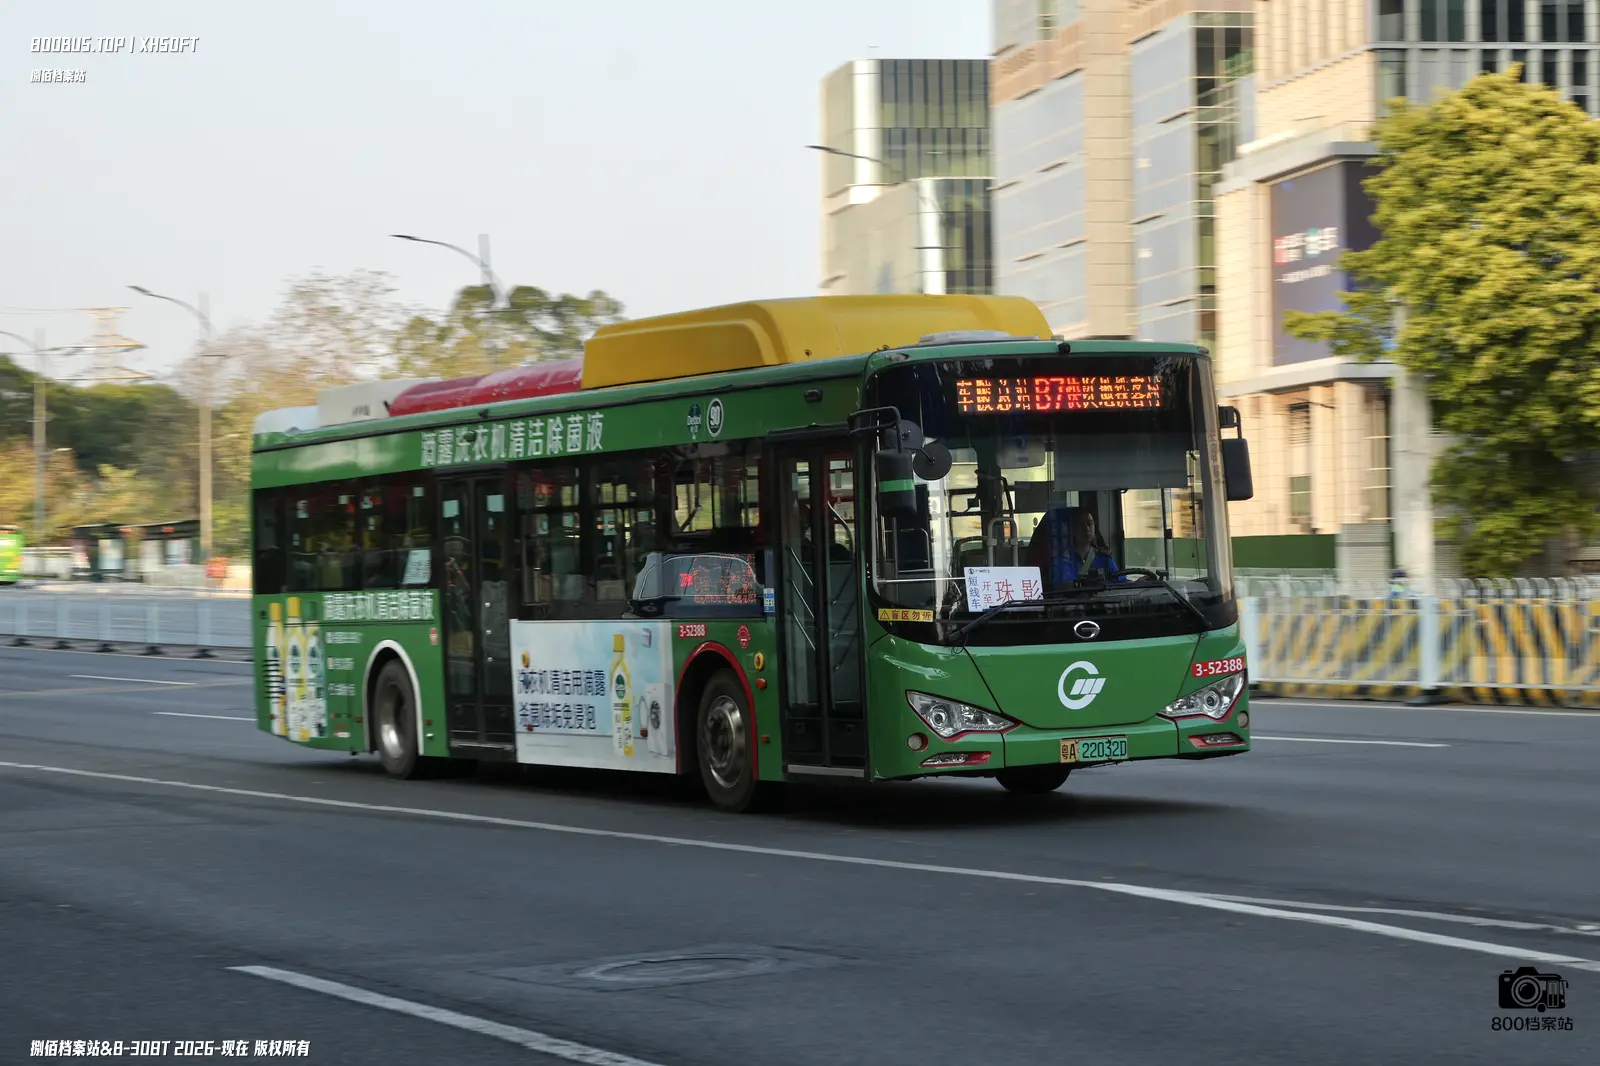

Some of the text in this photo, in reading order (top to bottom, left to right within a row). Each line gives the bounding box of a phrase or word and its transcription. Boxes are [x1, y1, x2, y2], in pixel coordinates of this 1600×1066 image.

[420, 412, 605, 467] 滴露洗衣机清洁除菌液
[968, 575, 981, 609] 短线车
[982, 581, 994, 604] 开至
[891, 609, 932, 621] 盲区勿近
[679, 624, 706, 637] 3-52388
[1195, 657, 1243, 677] 3-52388
